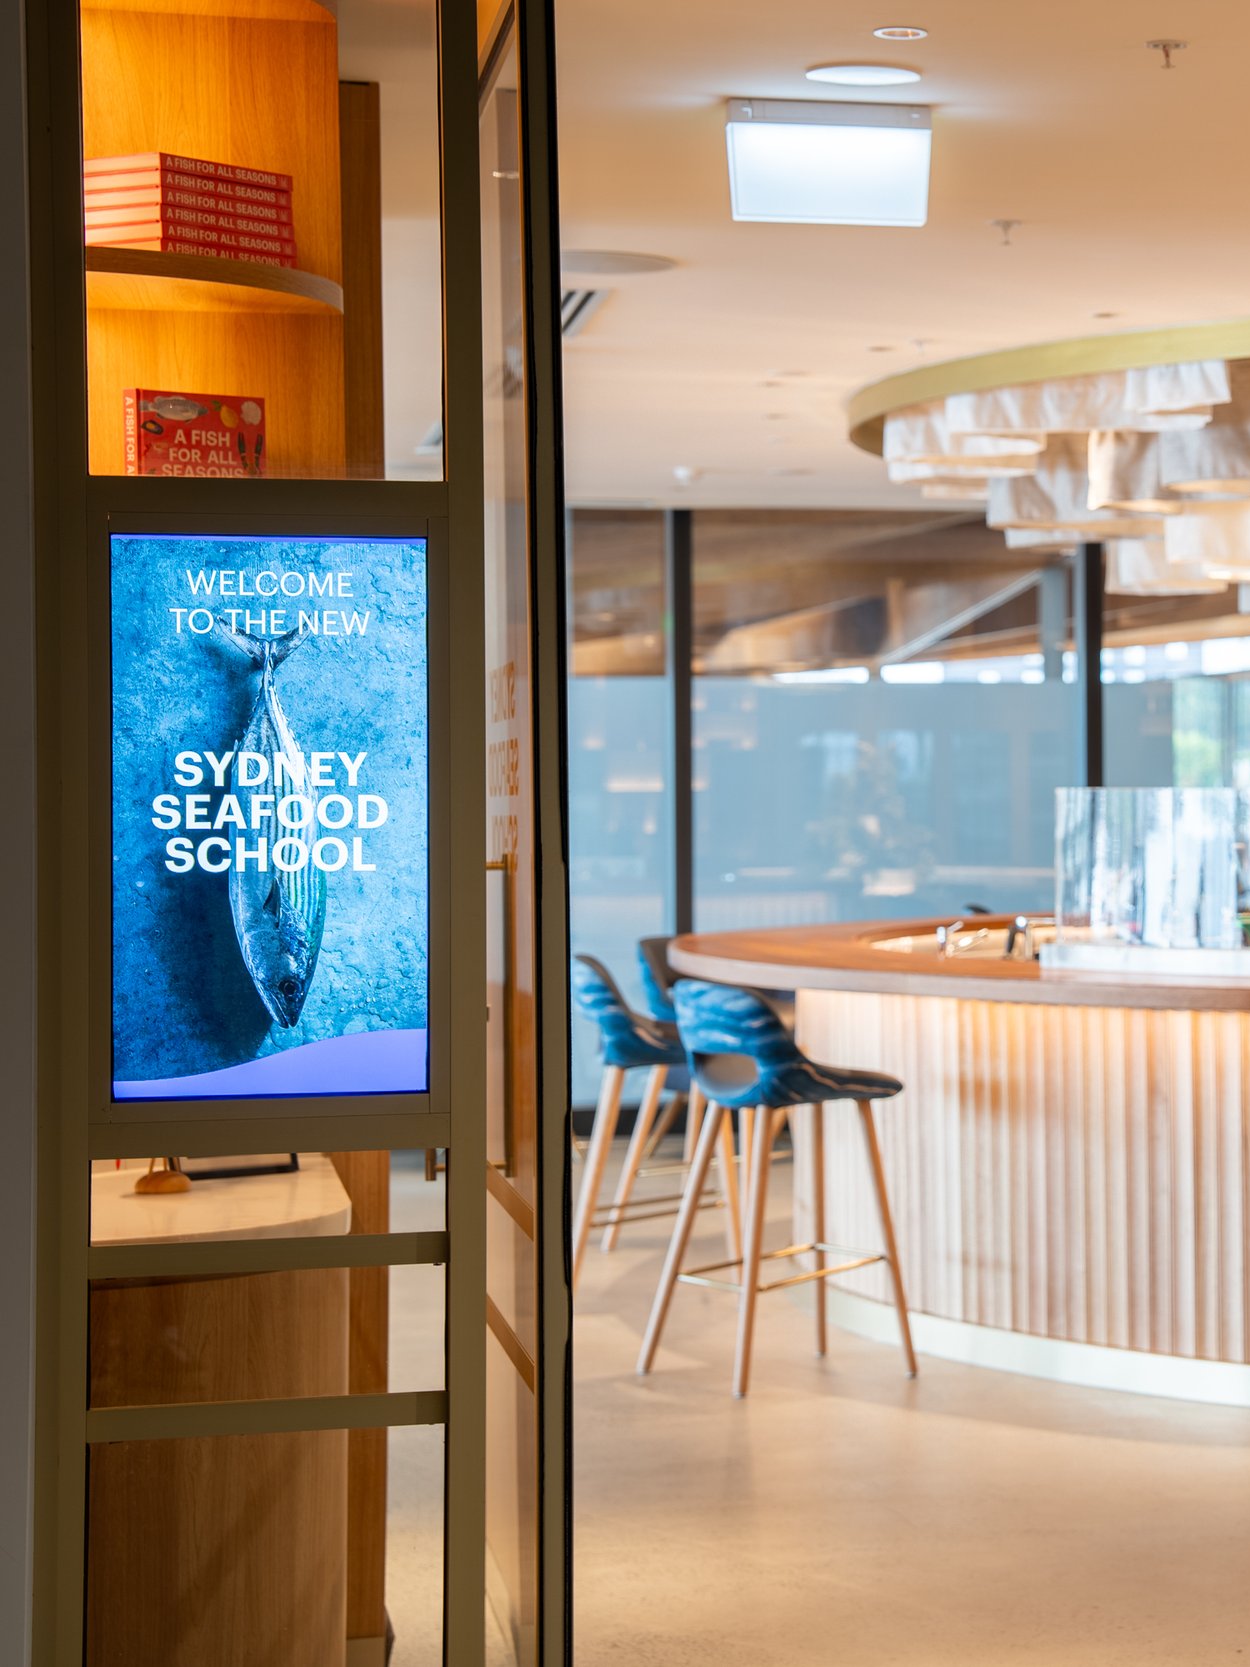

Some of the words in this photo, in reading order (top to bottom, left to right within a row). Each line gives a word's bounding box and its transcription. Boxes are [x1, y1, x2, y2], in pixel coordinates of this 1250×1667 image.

[166, 156, 173, 167] A
[175, 158, 195, 171] FISH
[197, 161, 215, 174] FOR
[217, 166, 233, 178] ALL
[235, 168, 277, 186] SEASONS
[166, 173, 174, 184] A
[175, 175, 195, 188] FISH
[197, 179, 215, 191] FOR
[217, 183, 233, 195] ALL
[235, 186, 276, 202] SEASONS
[167, 191, 174, 202] A
[175, 192, 196, 205] FISH
[197, 196, 216, 208] FOR
[218, 200, 234, 212] ALL
[236, 202, 277, 219] SEASONS
[167, 207, 173, 218] A
[175, 208, 196, 222] FISH
[198, 212, 216, 225] FOR
[218, 216, 235, 229] ALL
[236, 219, 279, 236] SEASONS
[168, 225, 175, 236] A
[177, 226, 197, 240] FISH
[200, 230, 218, 243] FOR
[221, 233, 237, 246] ALL
[239, 236, 281, 253] SEASONS
[125, 396, 134, 406] A
[125, 408, 134, 435] FISH
[126, 437, 135, 461] FOR
[174, 429, 187, 444] A
[191, 430, 230, 447] FISH
[168, 447, 201, 462] FOR
[207, 450, 238, 465] ALL
[162, 463, 244, 478] SEASONS
[186, 569, 354, 598] WELCOME
[169, 608, 214, 634] TO
[224, 609, 287, 635] THE
[299, 611, 371, 636] NEW
[173, 751, 368, 787] SYDNEY
[151, 793, 389, 830] SEAFOOD
[164, 836, 377, 874] SCHOOL
